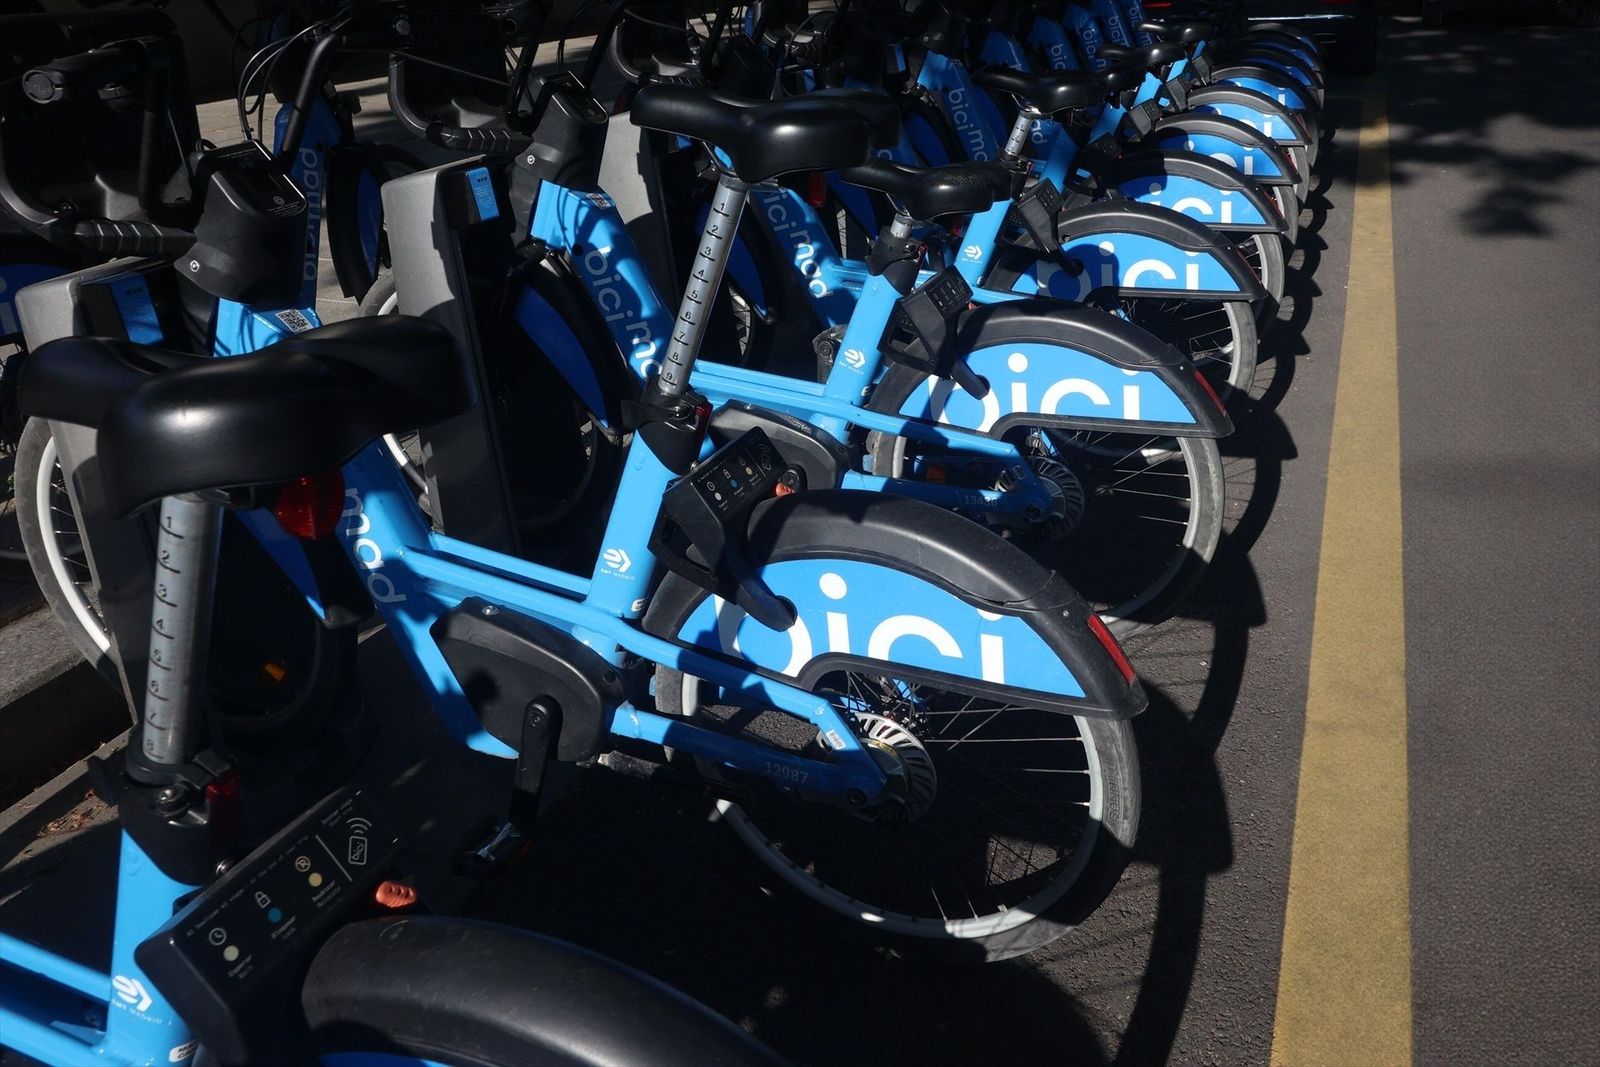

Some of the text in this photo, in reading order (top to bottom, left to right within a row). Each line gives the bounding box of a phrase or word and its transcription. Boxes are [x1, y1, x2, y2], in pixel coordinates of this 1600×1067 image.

[948, 87, 988, 161] bicima
[763, 191, 833, 299] icimad
[584, 246, 664, 379] bicima
[714, 572, 1005, 685] bici
